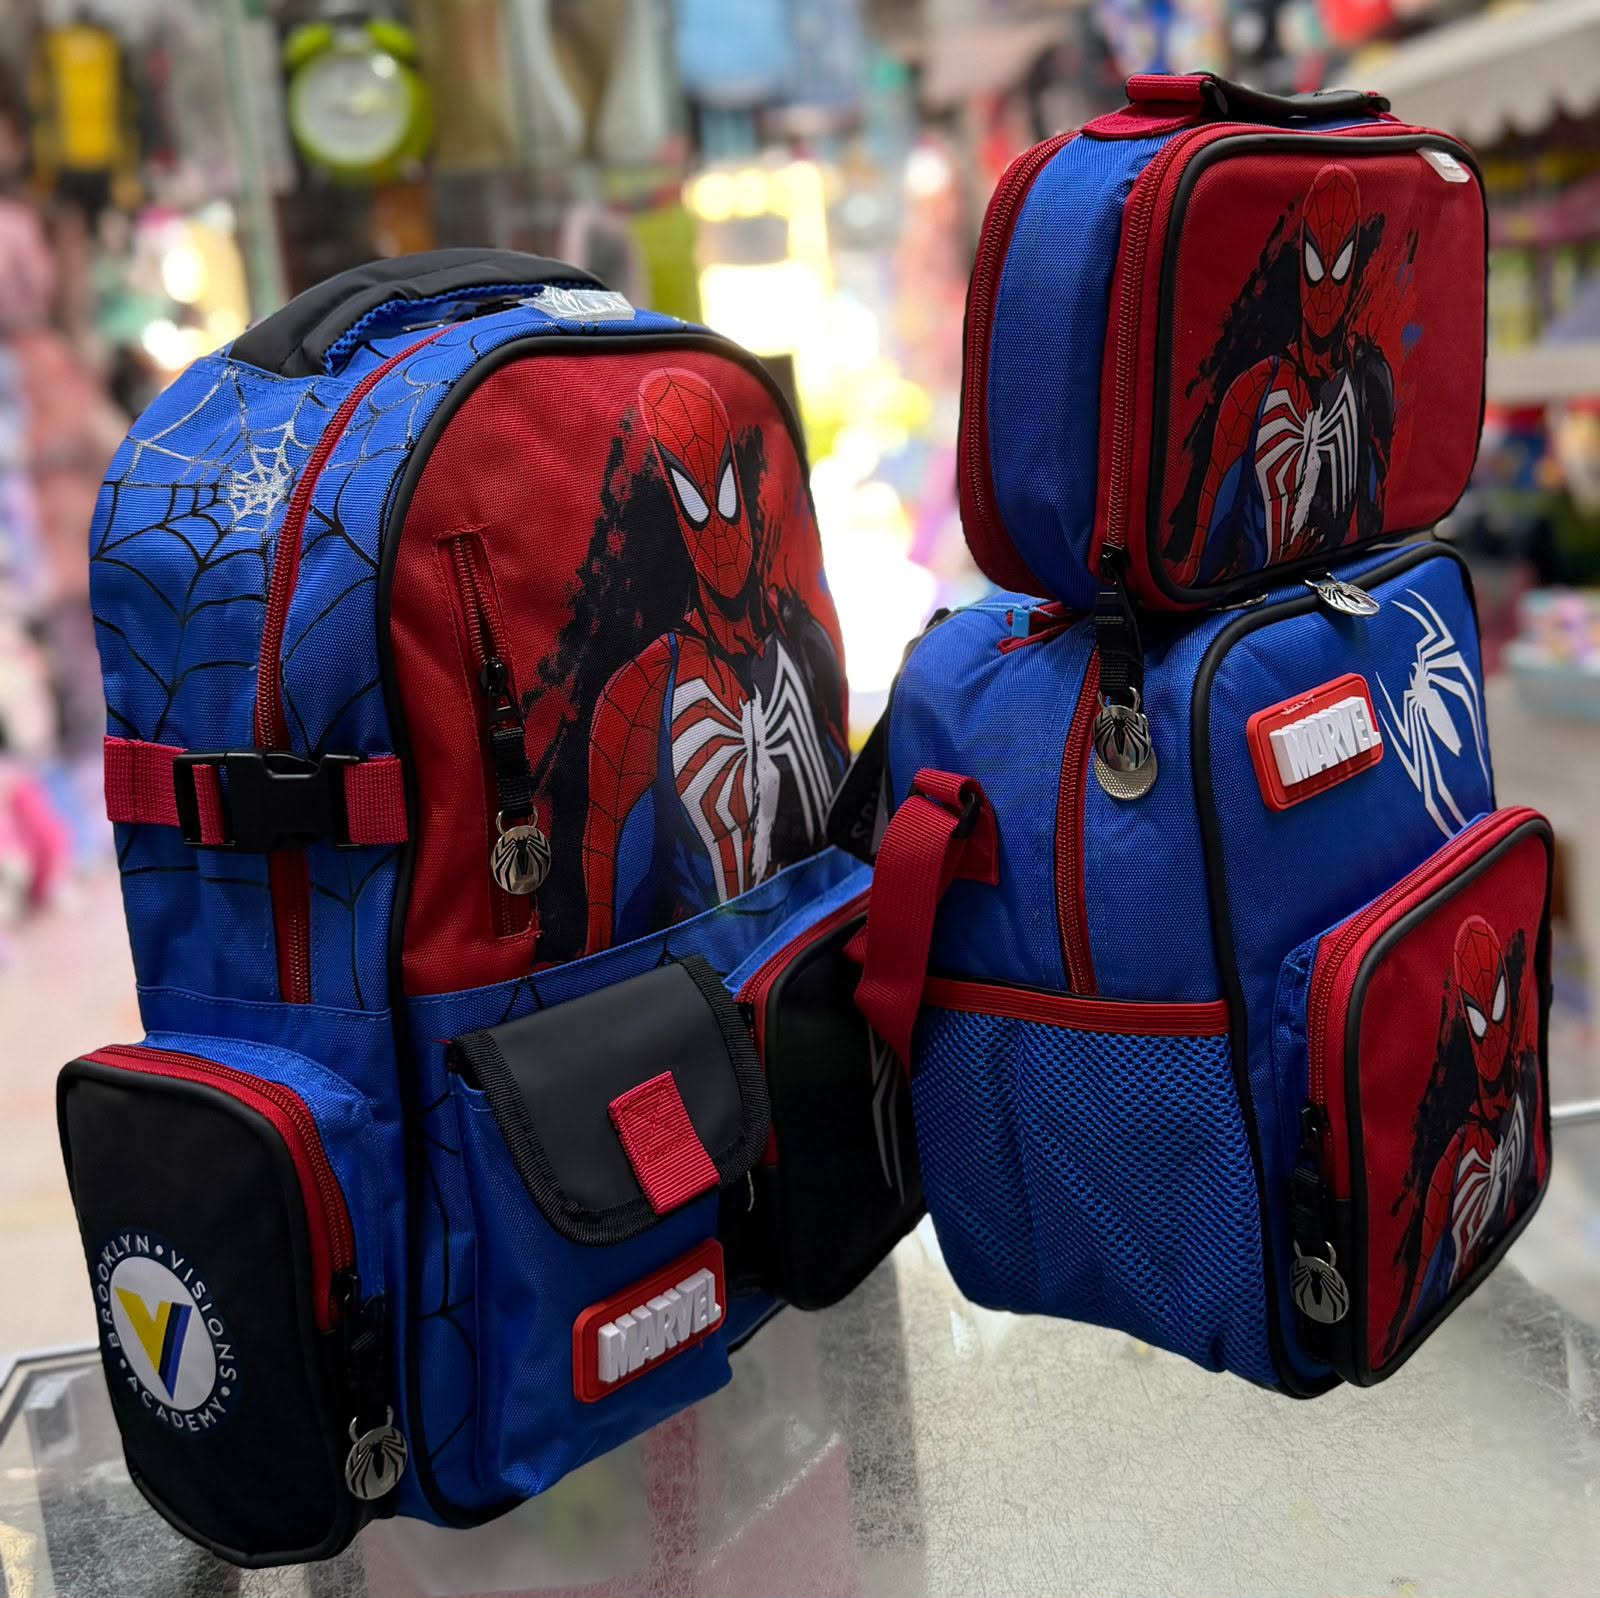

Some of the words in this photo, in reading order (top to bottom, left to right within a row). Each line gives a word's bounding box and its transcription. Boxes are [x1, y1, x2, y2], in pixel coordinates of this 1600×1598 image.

[1269, 696, 1382, 787] MARVEL
[97, 1234, 150, 1348] BROOKLYN
[171, 1250, 237, 1382] VISIONS
[598, 1267, 721, 1383] MARVEL
[127, 1376, 226, 1432] ACADEMY
